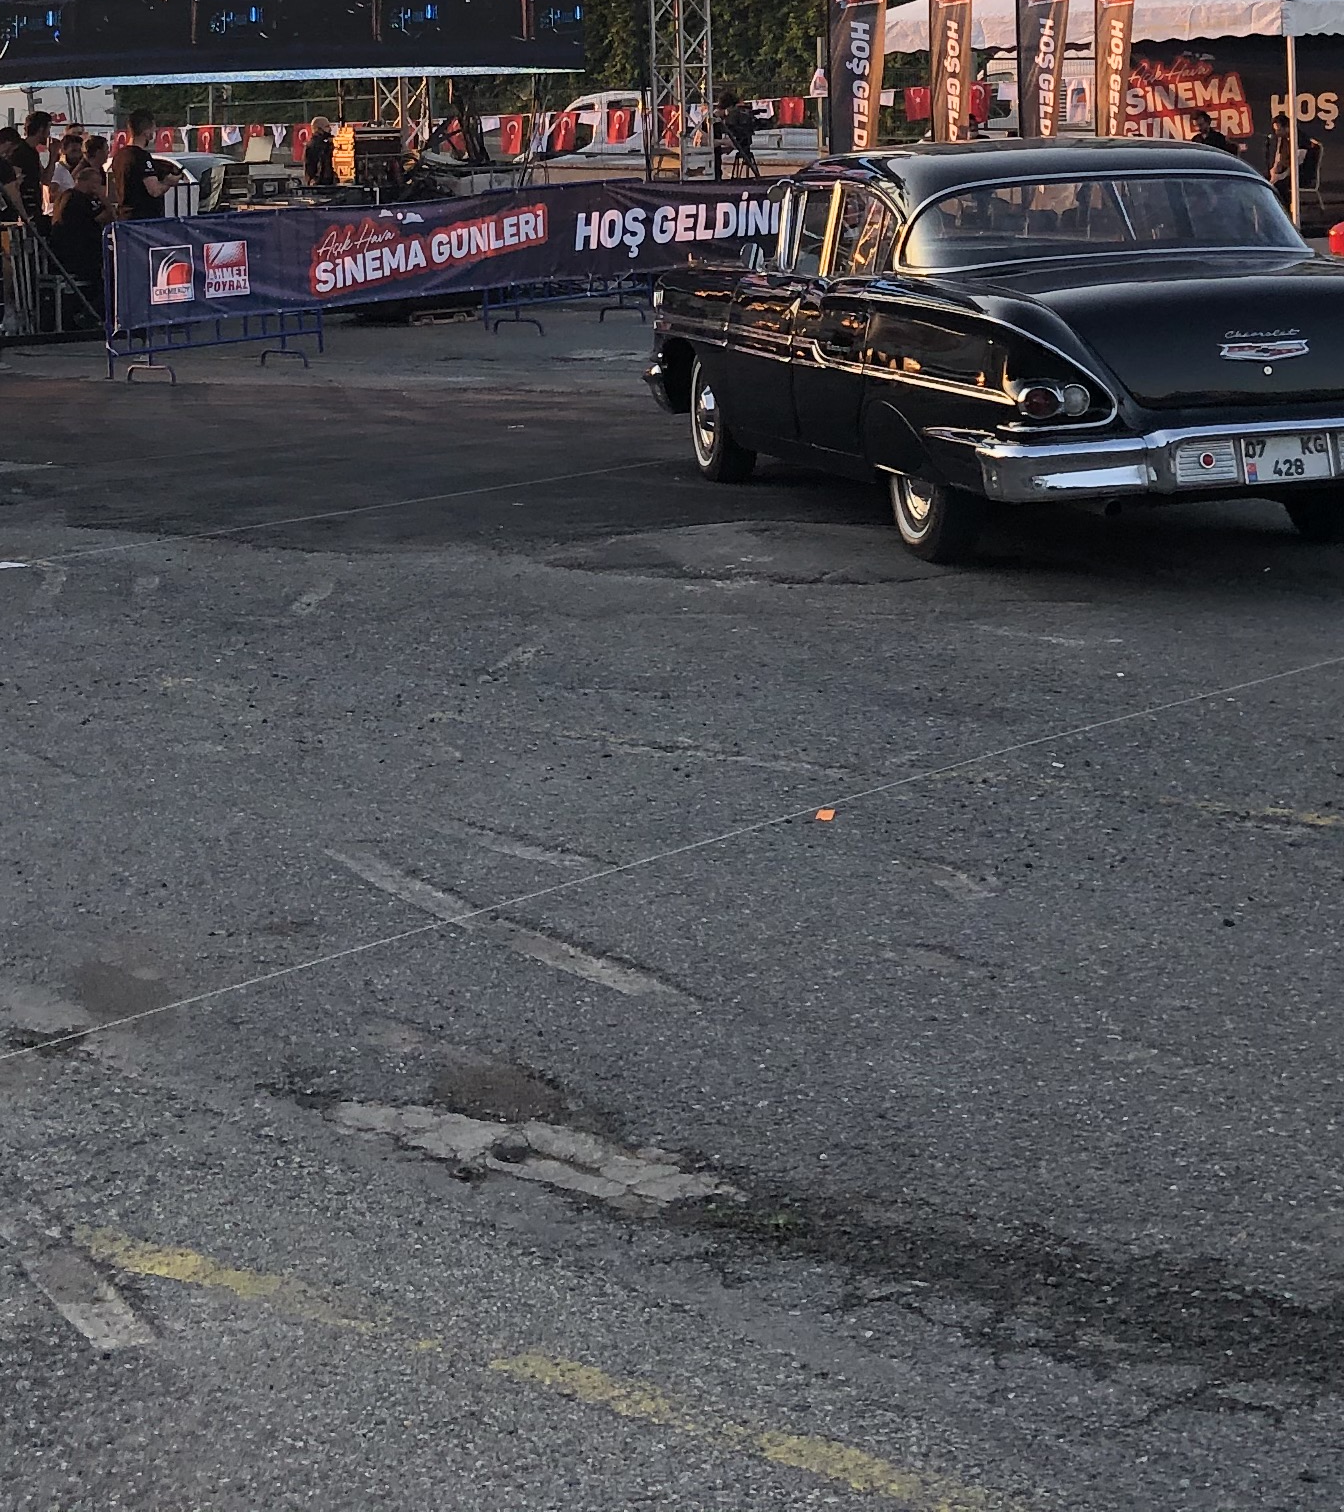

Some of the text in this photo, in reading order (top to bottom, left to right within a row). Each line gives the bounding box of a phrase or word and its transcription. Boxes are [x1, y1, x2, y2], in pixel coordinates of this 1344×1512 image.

[846, 21, 870, 76] HOŞ
[944, 20, 960, 74] HOŞ
[1035, 18, 1054, 70] HOŞ
[1107, 19, 1124, 71] HOŞ
[1126, 76, 1243, 116] SİNEMA
[1164, 60, 1211, 84] Hava
[852, 80, 869, 151] GELD
[947, 77, 960, 142] GELD
[1038, 73, 1054, 137] GELD
[1109, 74, 1121, 136] GELD
[316, 224, 396, 260] Açık Hava
[574, 191, 780, 258] HOŞ GELDİNİ
[208, 266, 247, 280] AHMET
[315, 210, 544, 293] SİNEMA GÜNLERİ
[207, 279, 248, 292] POYRAZ
[1224, 328, 1301, 339] Chevrolet
[1245, 434, 1327, 459] 07 KG
[1273, 458, 1305, 477] 428
